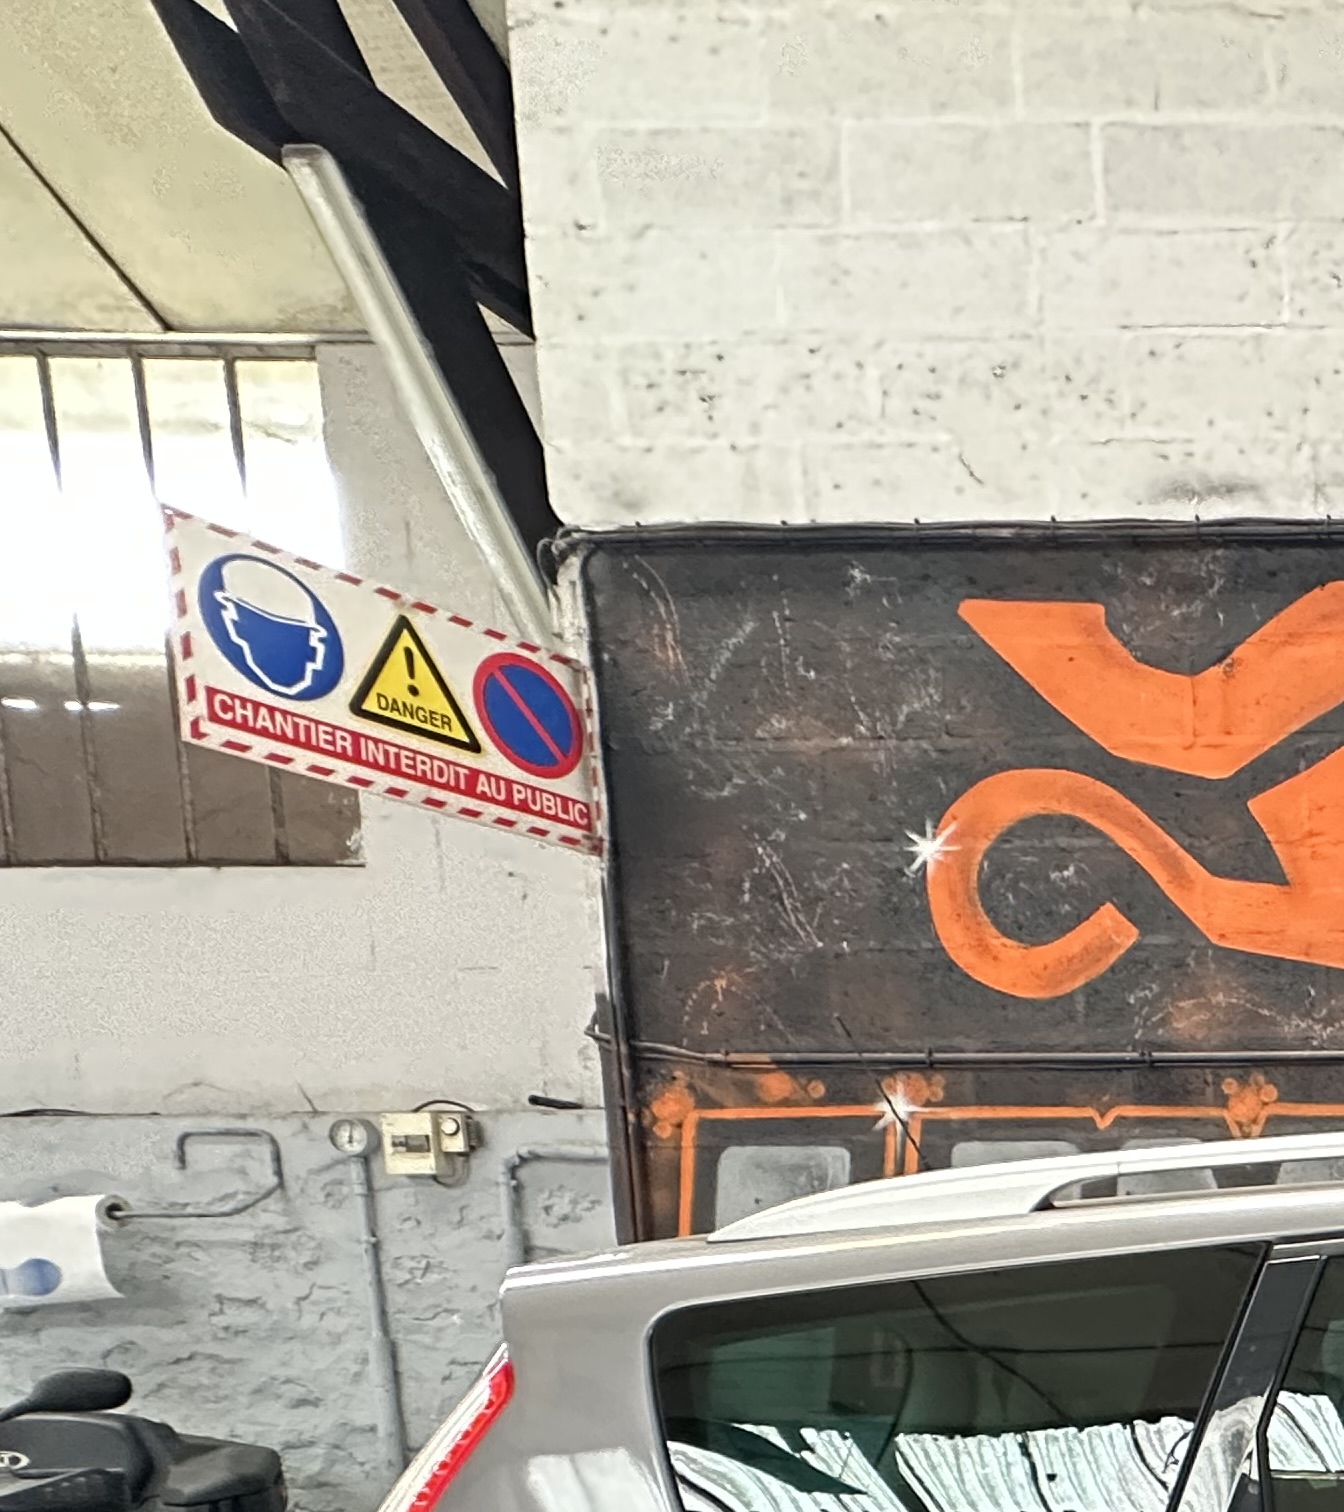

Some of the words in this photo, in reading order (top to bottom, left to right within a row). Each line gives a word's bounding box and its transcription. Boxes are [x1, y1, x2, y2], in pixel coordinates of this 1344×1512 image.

[376, 693, 453, 732] DANGER
[213, 694, 353, 758] CHANTIER
[360, 740, 469, 792] INTERDIT
[475, 776, 507, 803] AU
[513, 785, 589, 826] PUBLIC
